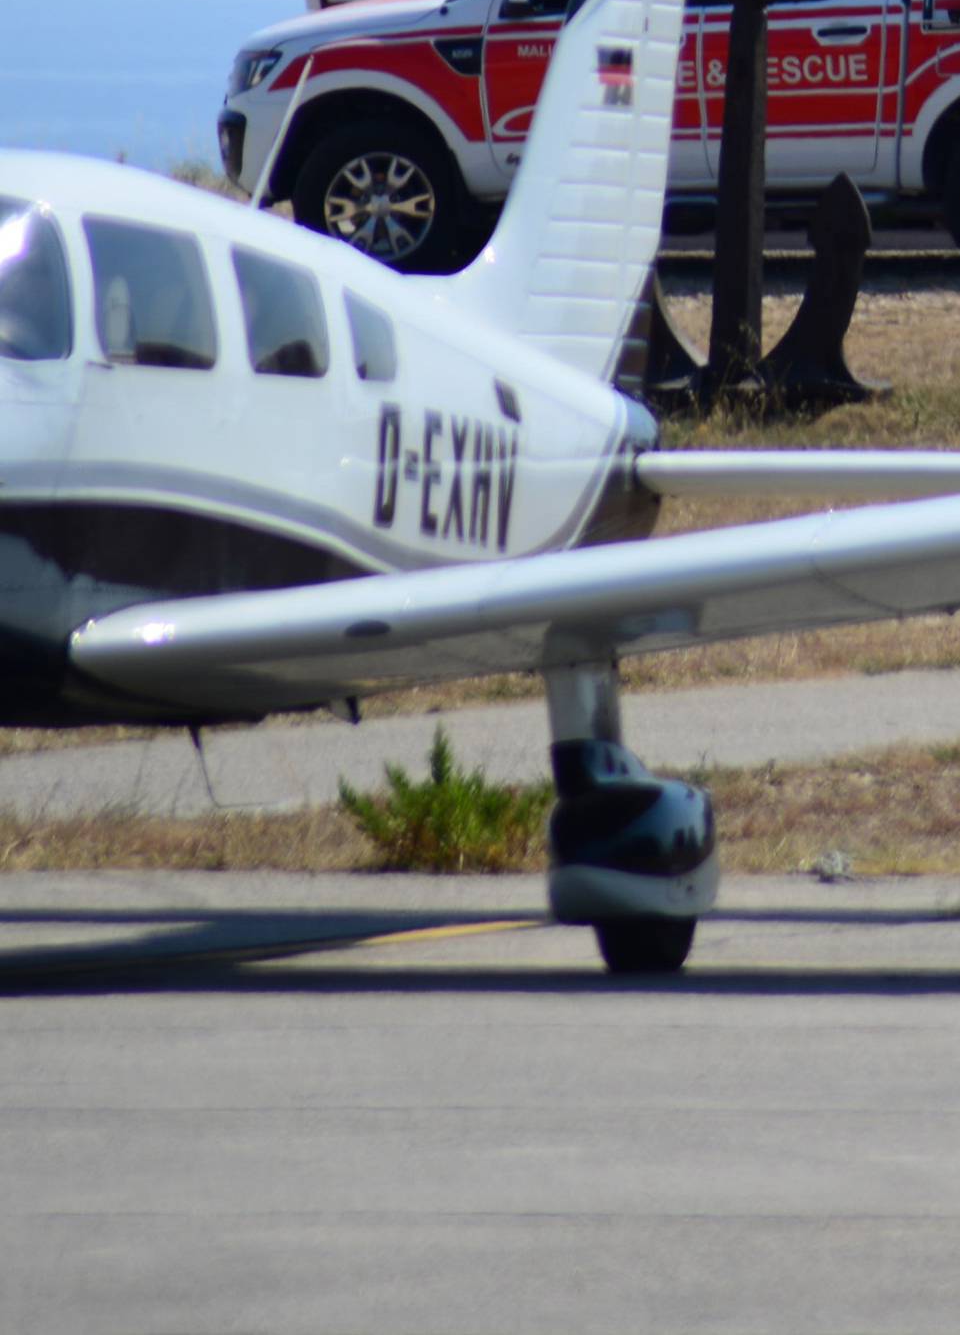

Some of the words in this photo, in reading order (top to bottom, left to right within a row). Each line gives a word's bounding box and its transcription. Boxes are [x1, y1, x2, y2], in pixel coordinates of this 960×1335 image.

[706, 59, 728, 86] &
[766, 53, 868, 83] ESCUE
[374, 402, 517, 553] D-EXHV
